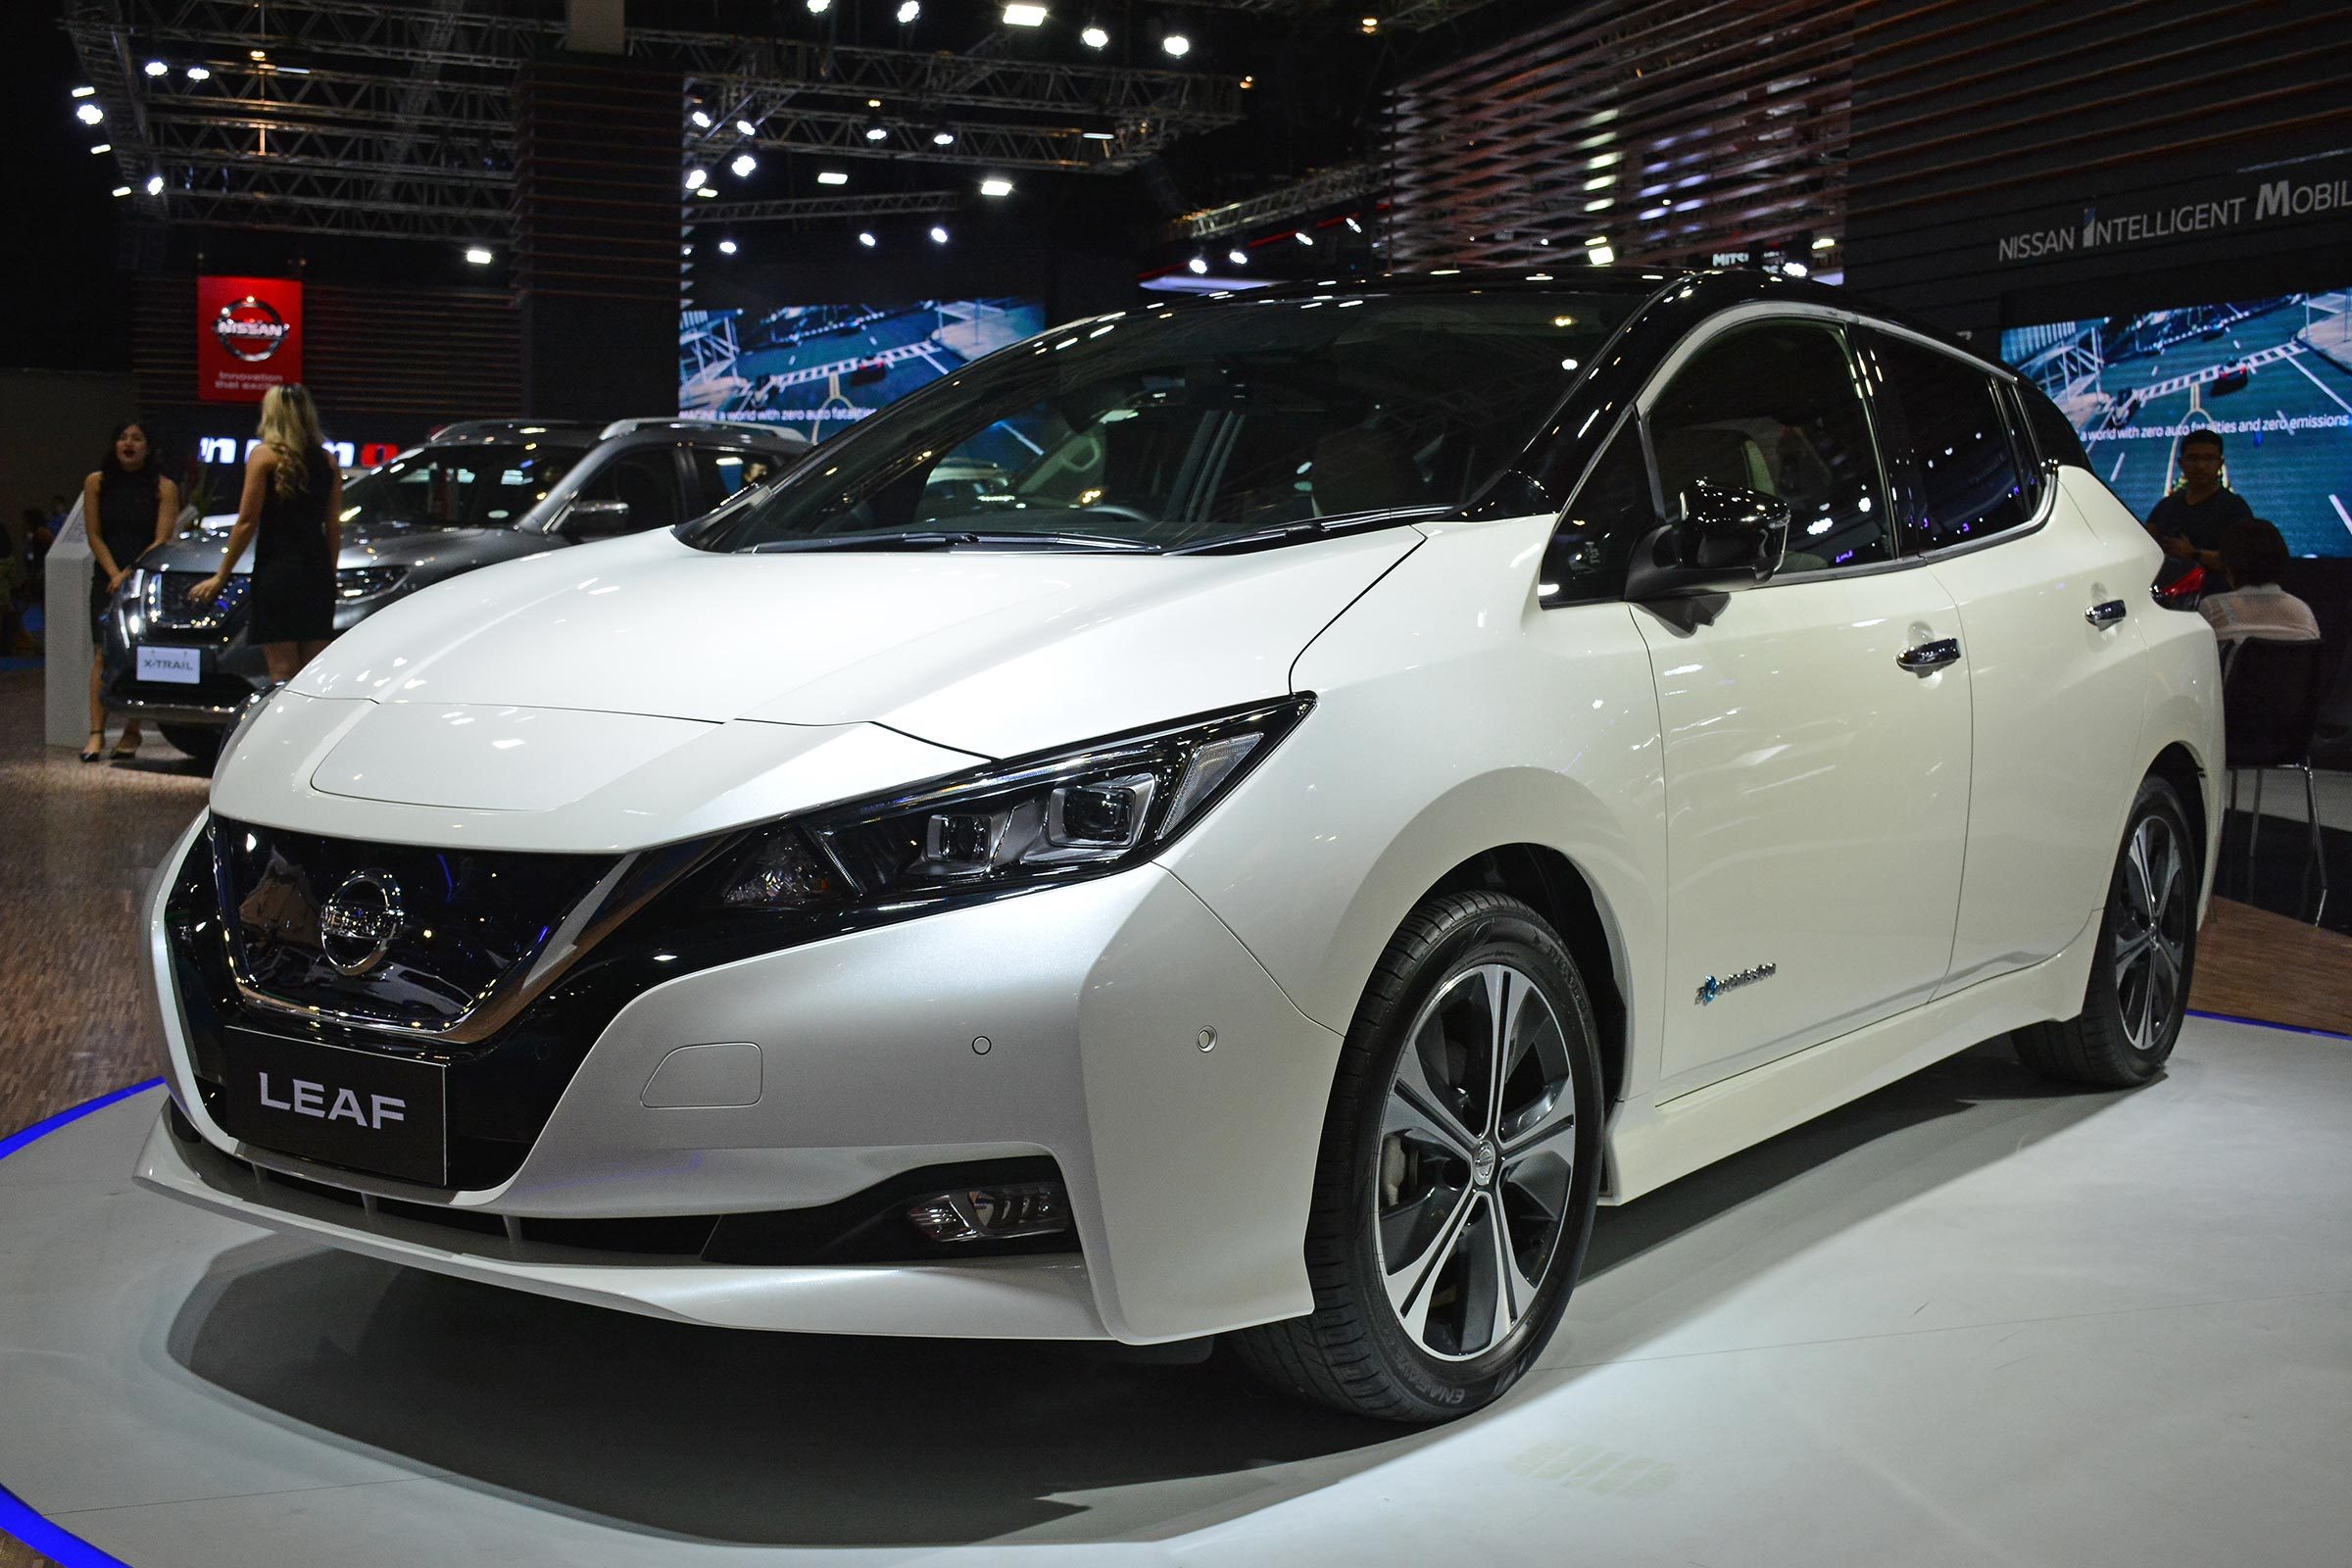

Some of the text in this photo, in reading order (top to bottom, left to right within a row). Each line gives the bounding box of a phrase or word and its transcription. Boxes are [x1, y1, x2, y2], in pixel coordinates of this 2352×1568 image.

[1998, 179, 2352, 262] NISSAN INTELLIGENT MOBIL
[217, 320, 284, 337] NISSAN
[219, 371, 283, 382] Innovation
[726, 410, 757, 420] world
[757, 408, 780, 420] with
[781, 410, 805, 420] zero
[806, 409, 831, 420] auto
[2080, 430, 2088, 442] a
[2087, 427, 2117, 441] world
[2117, 425, 2140, 439] with
[2140, 427, 2164, 439] zero
[2164, 424, 2190, 437] auto
[2237, 418, 2261, 432] and
[2261, 417, 2287, 431] zero
[2288, 413, 2350, 429] emissions
[142, 659, 194, 671] X-TRAIL
[258, 1071, 407, 1130] LEAF
